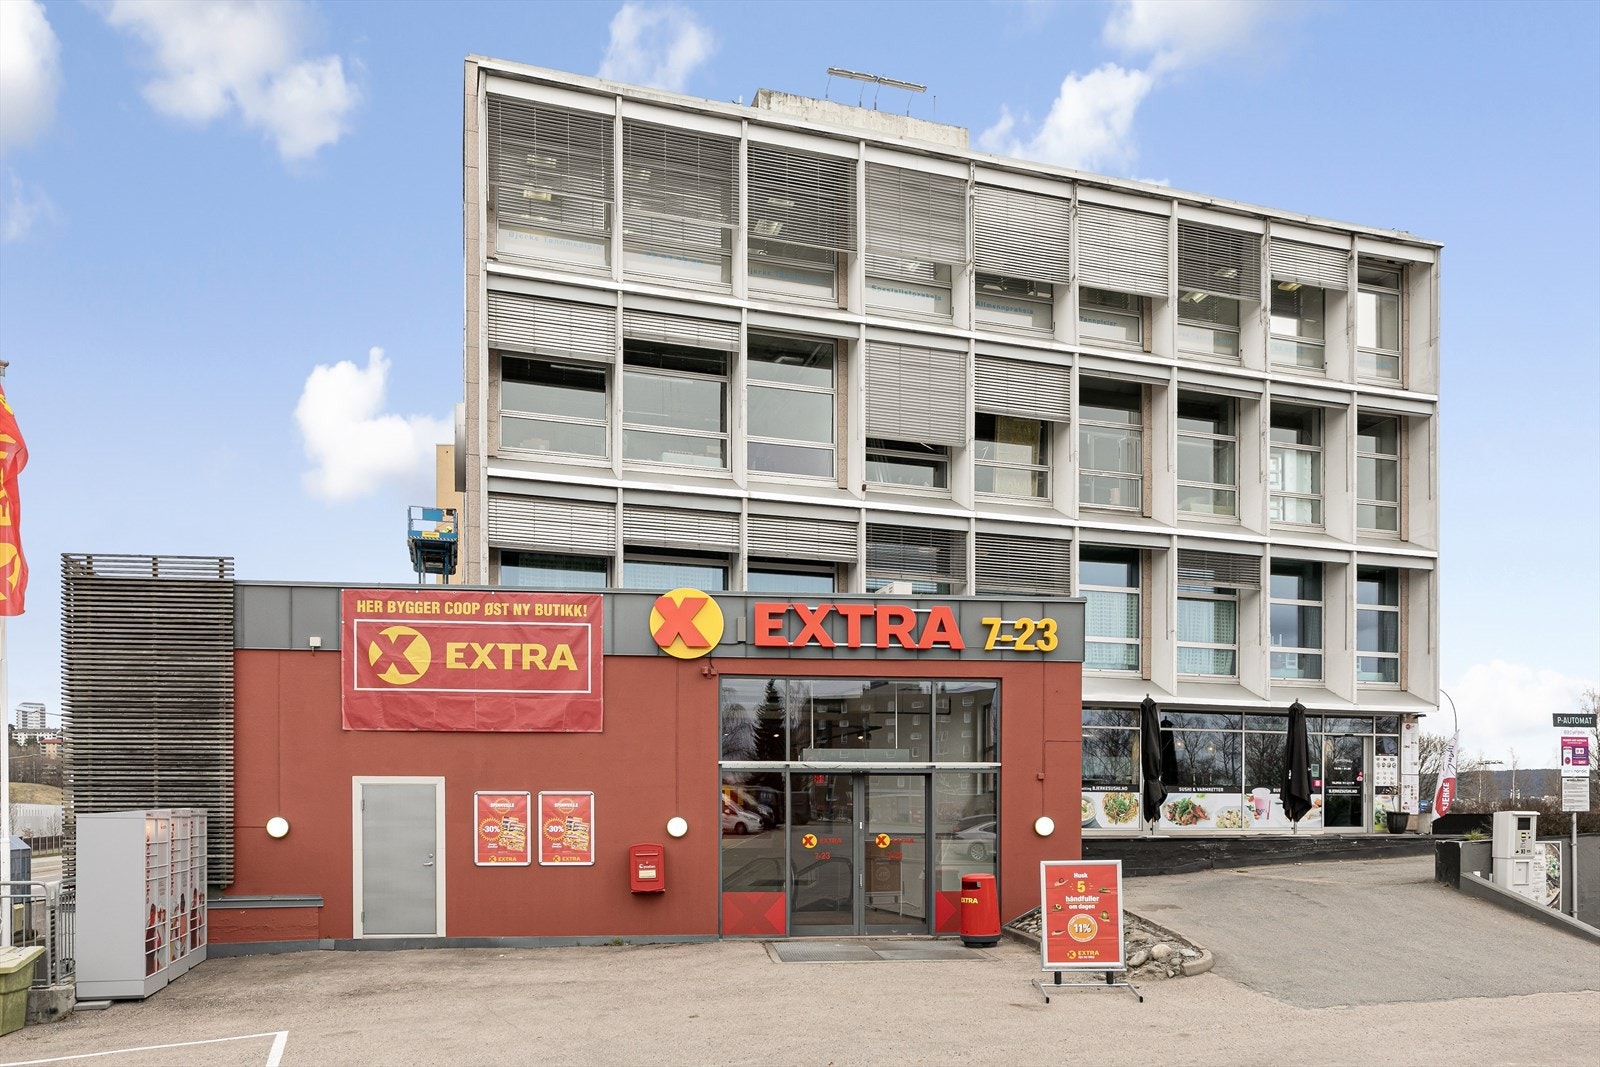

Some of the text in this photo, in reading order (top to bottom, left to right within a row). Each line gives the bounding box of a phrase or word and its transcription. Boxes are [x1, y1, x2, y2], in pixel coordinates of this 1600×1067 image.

[356, 600, 588, 618] HER BYGGER COOP ØST NY BUTIKK!
[754, 602, 965, 650] EXTRA
[981, 616, 1059, 652] 7-23
[446, 642, 578, 671] EXTRA
[1556, 716, 1592, 724] P-AUTOMAT
[1077, 880, 1086, 893] 5
[1074, 924, 1092, 933] 11%
